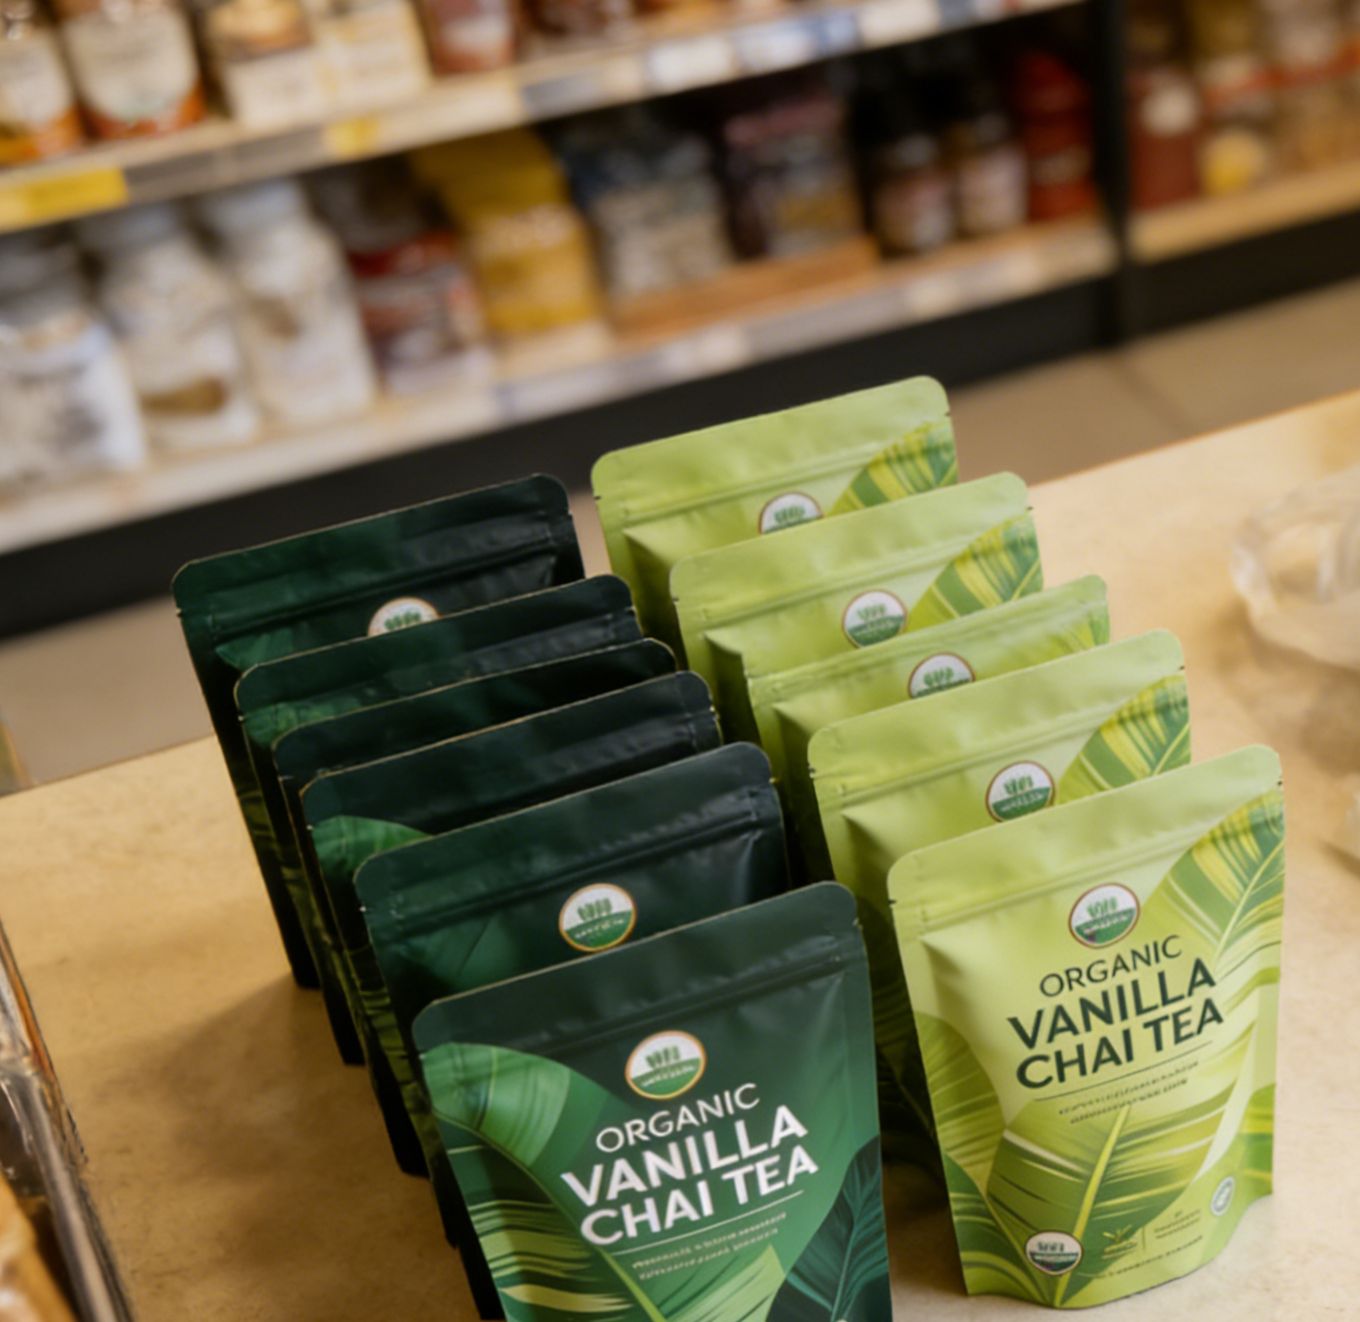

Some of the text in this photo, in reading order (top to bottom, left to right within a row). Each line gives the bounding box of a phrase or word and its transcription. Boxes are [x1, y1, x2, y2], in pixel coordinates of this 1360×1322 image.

[1006, 957, 1217, 1050] VANILLA
[1039, 934, 1182, 998] ORGANIC
[1016, 1028, 1134, 1089] CHAI
[1142, 997, 1224, 1052] TEA
[560, 1104, 808, 1207] VANILLA
[595, 1082, 760, 1153] ORGANIC
[580, 1180, 714, 1245] CHAI
[721, 1144, 819, 1205] TEA
